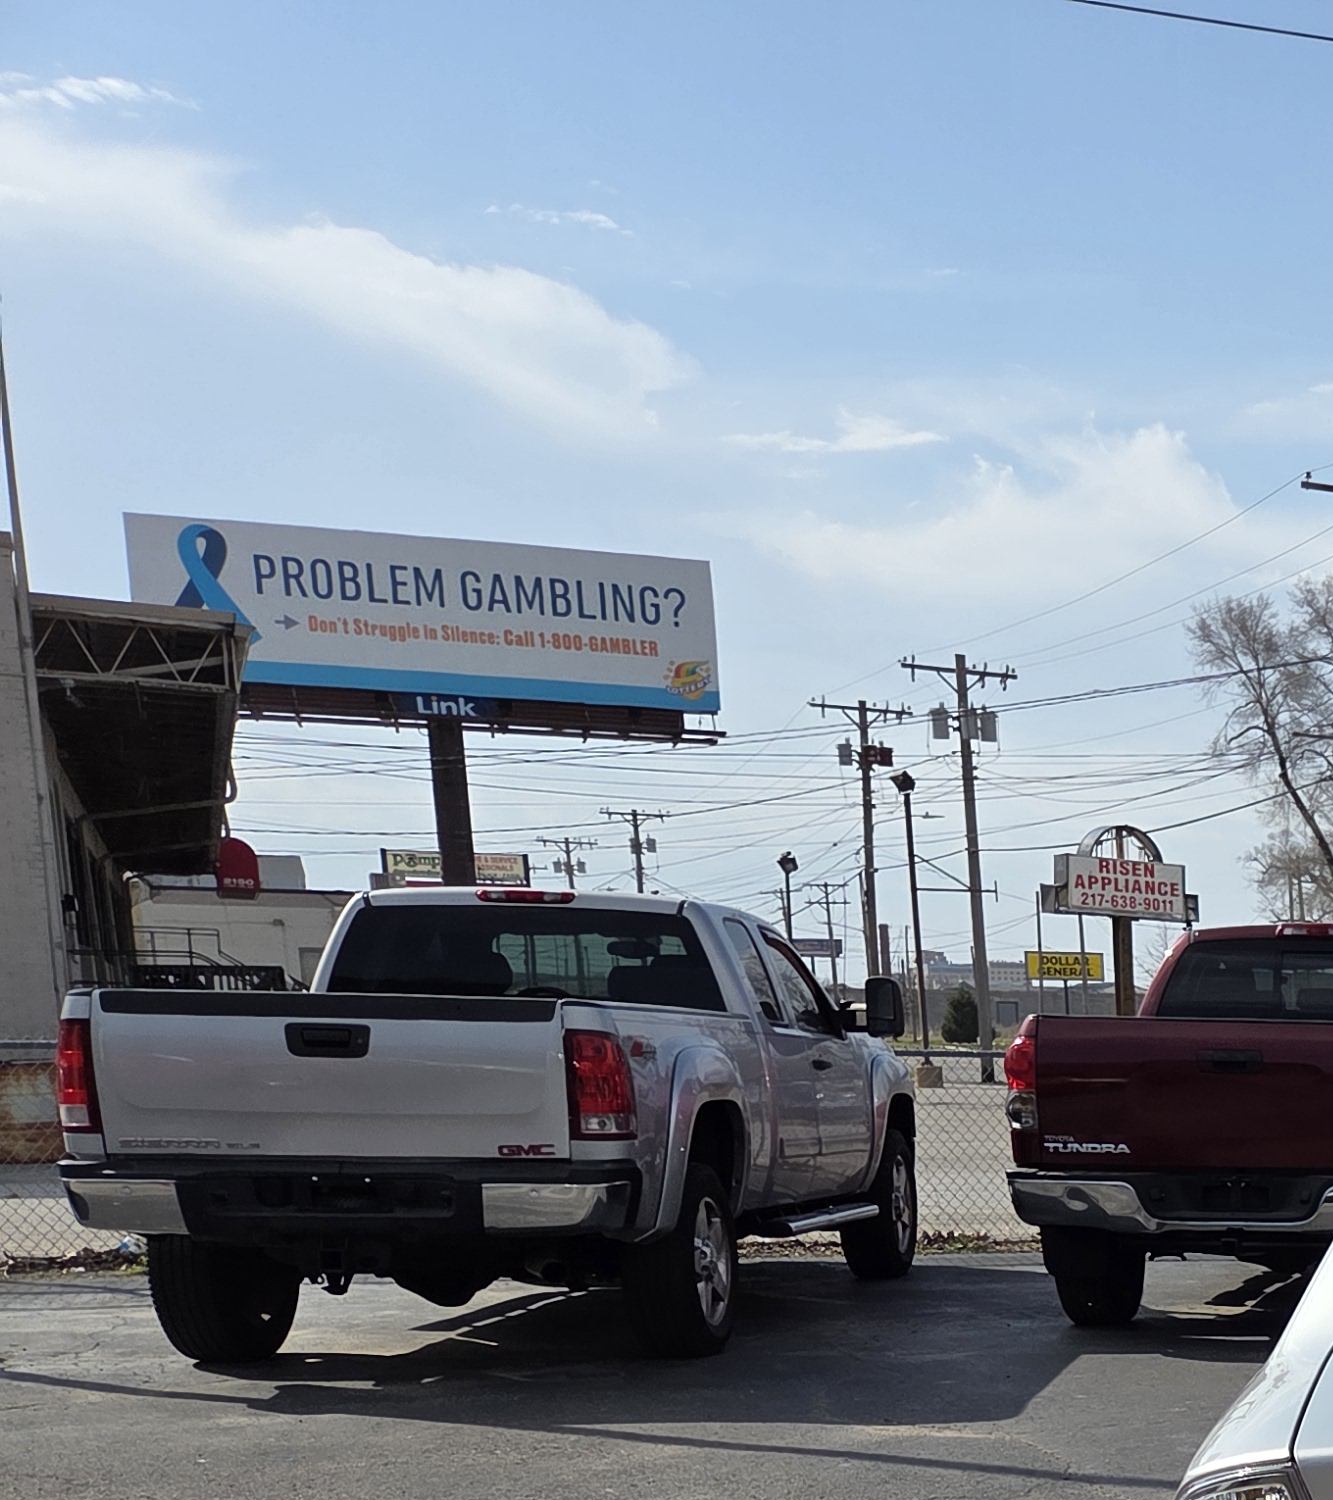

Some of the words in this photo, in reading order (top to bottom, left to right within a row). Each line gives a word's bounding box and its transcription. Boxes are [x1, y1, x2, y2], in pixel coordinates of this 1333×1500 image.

[253, 554, 446, 608] PROBLEM
[460, 570, 686, 628] GAMBLING?
[308, 614, 349, 635] Don't
[353, 617, 420, 642] Struggle
[441, 624, 500, 645] Silence:
[503, 629, 535, 648] Call
[538, 632, 659, 657] 1-800-GAMBLER
[416, 695, 478, 717] Link
[1099, 859, 1155, 878] RISEN
[1074, 874, 1180, 897] APPLIANCE
[1081, 892, 1174, 912] 217-638-9011
[1040, 955, 1090, 966] DOLLAR
[498, 1144, 556, 1156] GMC
[1044, 1142, 1131, 1154] TUNDRA
